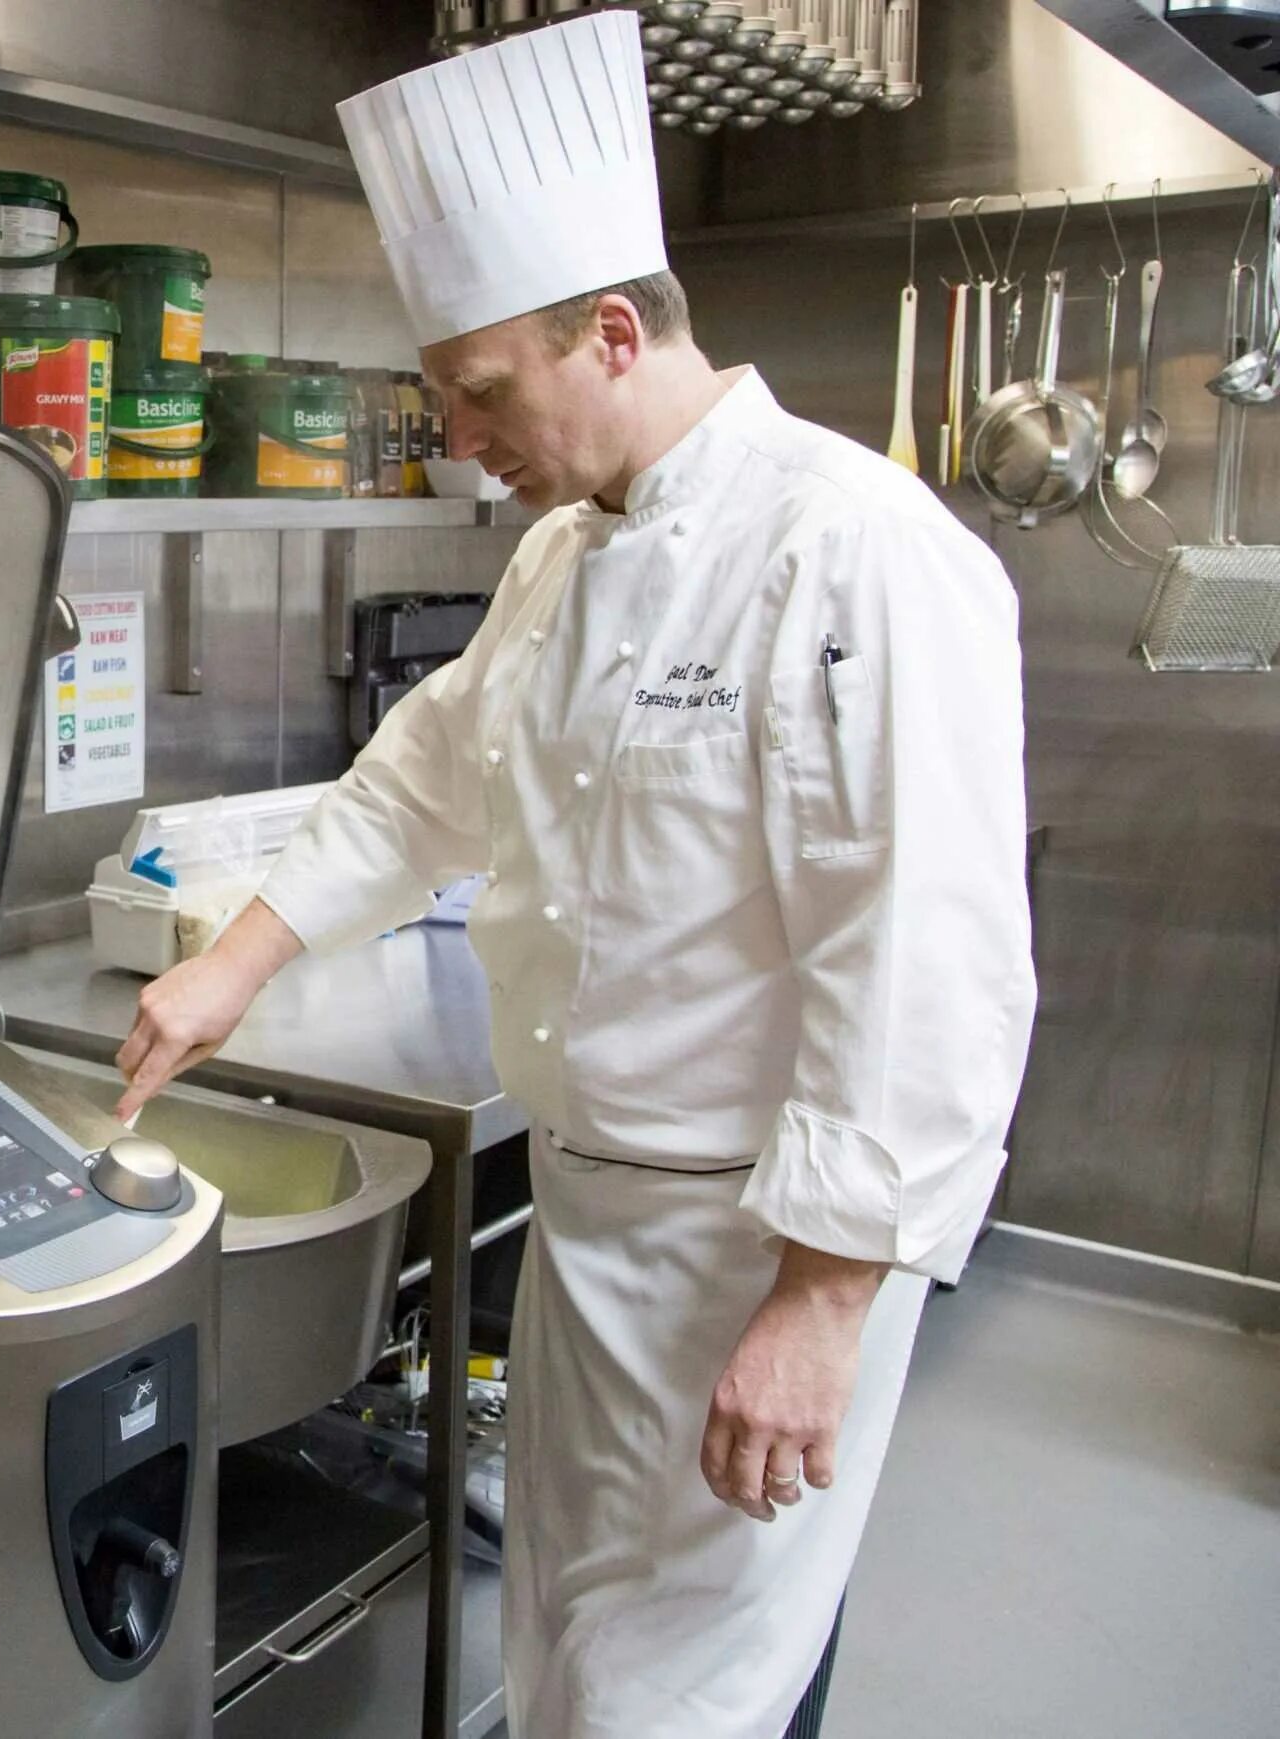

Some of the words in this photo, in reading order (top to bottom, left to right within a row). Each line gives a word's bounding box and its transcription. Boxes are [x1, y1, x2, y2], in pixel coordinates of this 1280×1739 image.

[36, 394, 69, 404] GRAVY
[70, 394, 86, 404] MIX
[90, 631, 106, 645] RAW
[109, 628, 128, 643] MEAT
[110, 657, 127, 672] FISH
[708, 685, 742, 712] Chef
[84, 717, 106, 732] SALAD
[115, 713, 135, 728] FRUIT
[88, 742, 131, 760] VEGETABLES
